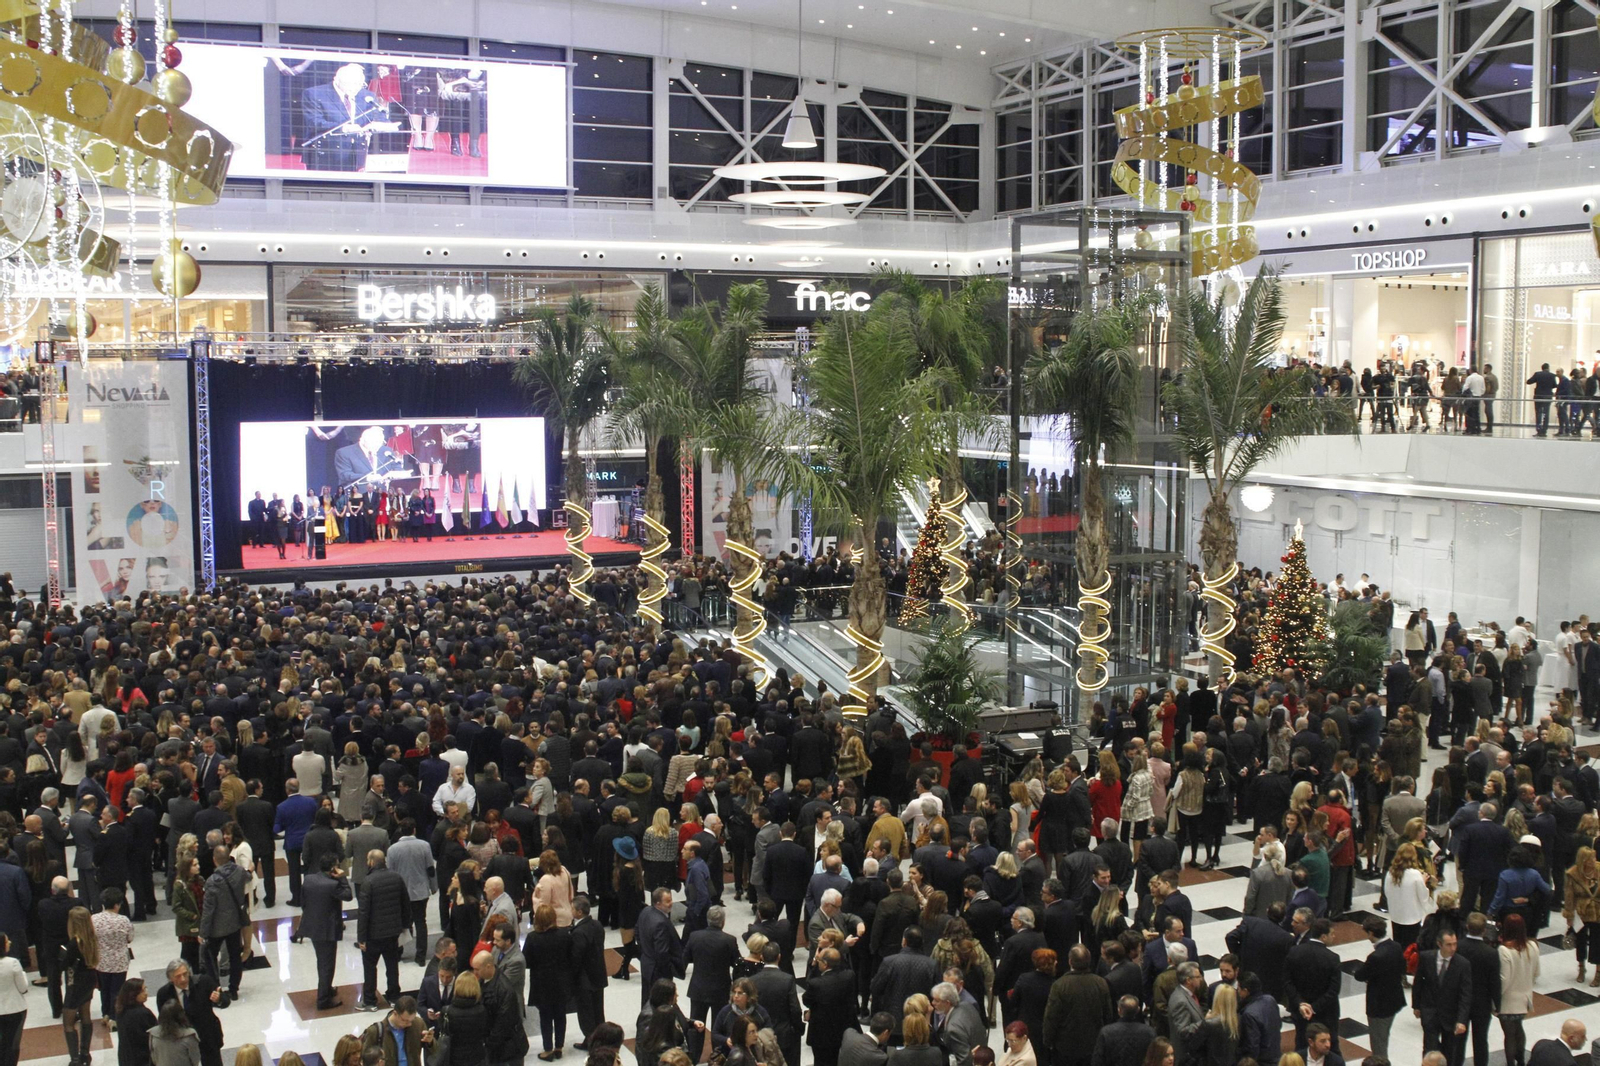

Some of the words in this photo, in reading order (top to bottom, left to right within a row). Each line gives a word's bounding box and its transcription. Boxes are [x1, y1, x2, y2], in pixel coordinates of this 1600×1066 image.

[1351, 248, 1426, 271] TOPSHOP
[358, 284, 496, 319] Bershka
[794, 282, 872, 312] fnac
[111, 402, 145, 410] SHOPPING
[586, 471, 617, 480] MARK
